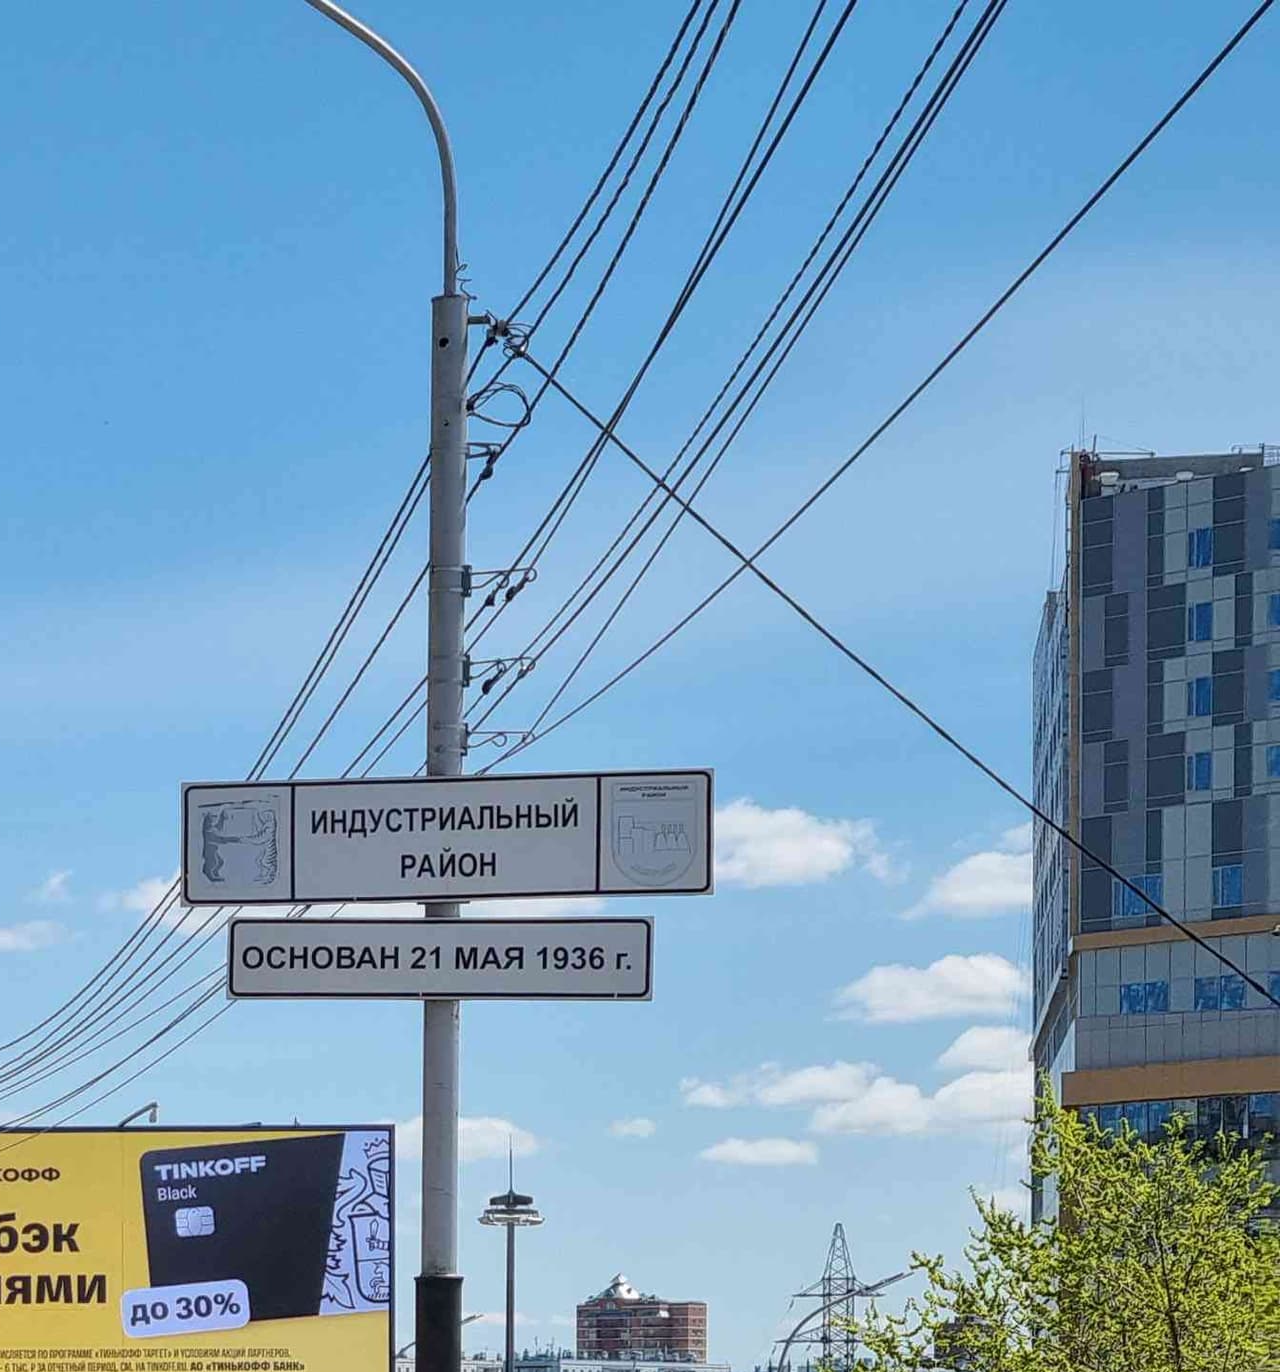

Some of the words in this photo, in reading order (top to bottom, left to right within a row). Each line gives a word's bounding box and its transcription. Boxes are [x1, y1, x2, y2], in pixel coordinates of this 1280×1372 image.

[311, 797, 579, 839] ИНДУСТРИАЛЬНЫЙ
[400, 847, 497, 879] РАЙОН
[241, 946, 400, 970] ОСНОВАН
[410, 946, 442, 970] 21
[454, 946, 524, 970] МАЯ
[536, 946, 606, 970] 1936
[615, 950, 633, 970] г.
[153, 1155, 266, 1181] TINKOFF
[157, 1184, 197, 1202] Black
[130, 1302, 169, 1327] до
[175, 1292, 240, 1320] 30%
